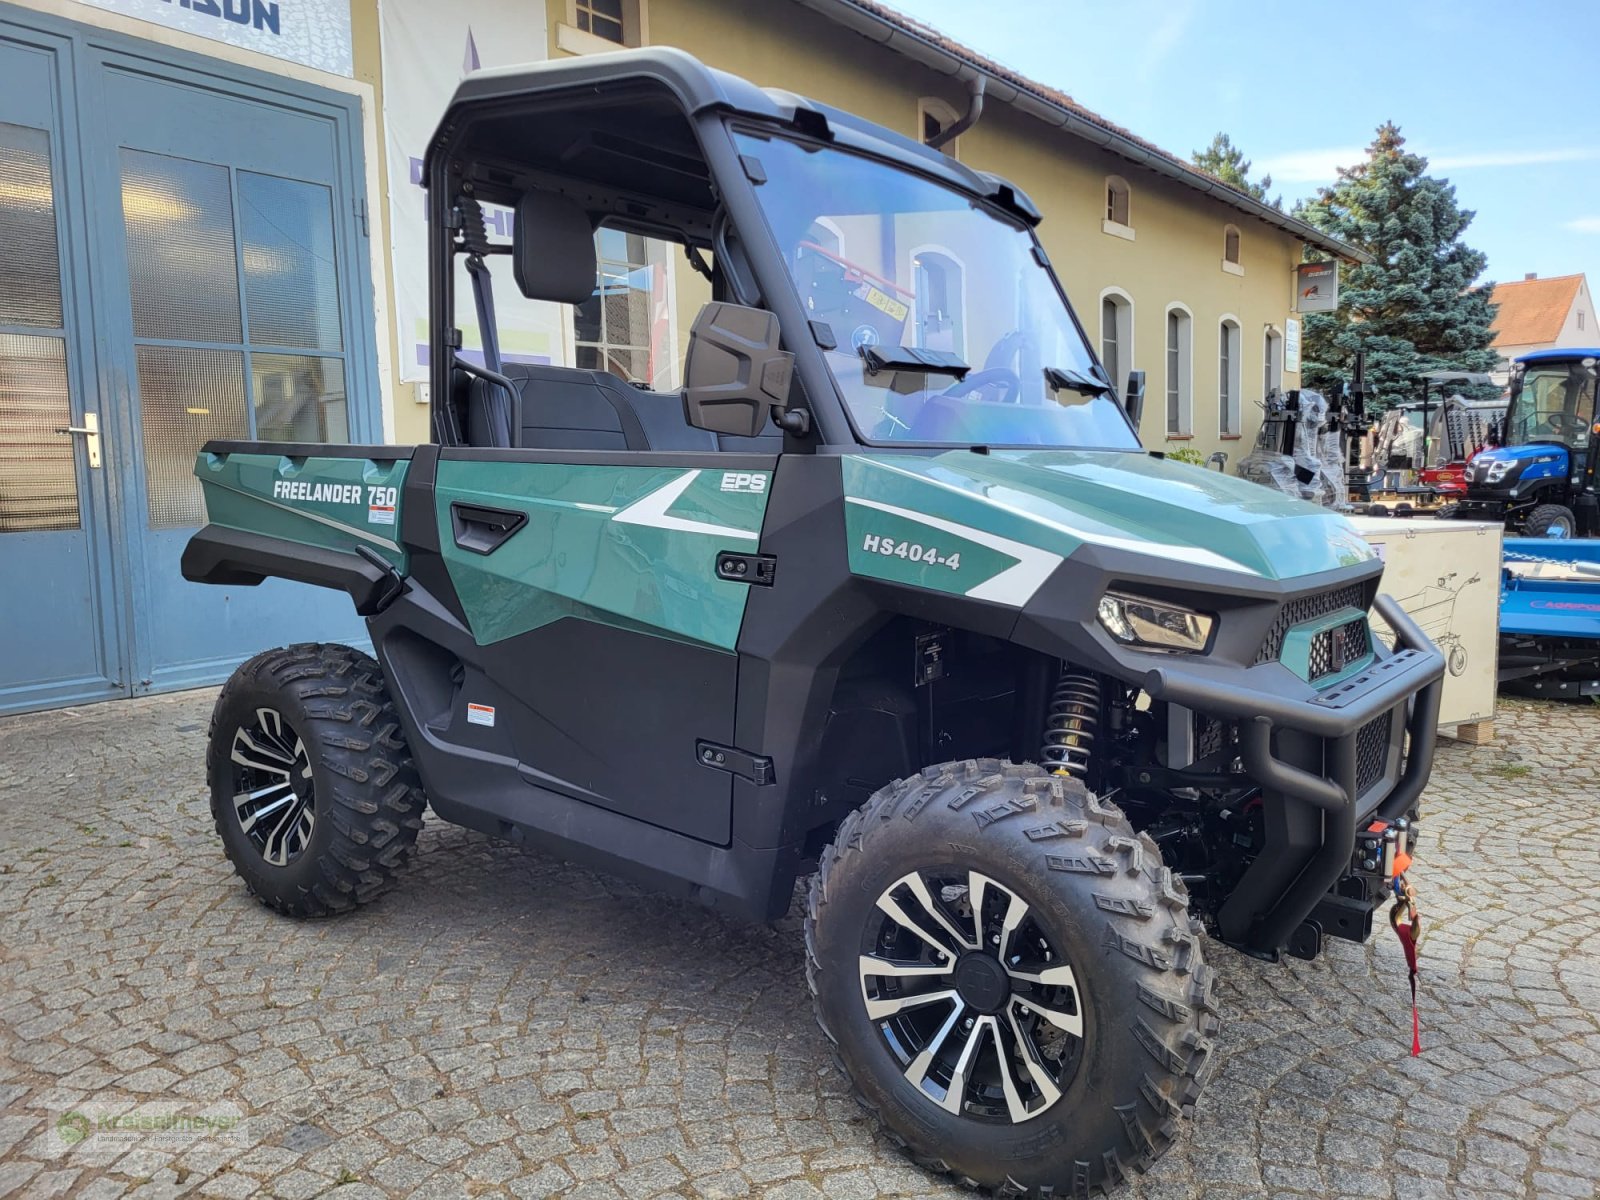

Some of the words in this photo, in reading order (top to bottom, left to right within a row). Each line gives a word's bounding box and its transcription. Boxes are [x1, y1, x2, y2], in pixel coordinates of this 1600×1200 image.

[273, 480, 362, 504] FREELANDER
[367, 486, 397, 506] 750
[721, 472, 767, 490] EPS
[863, 534, 960, 570] HS404-4
